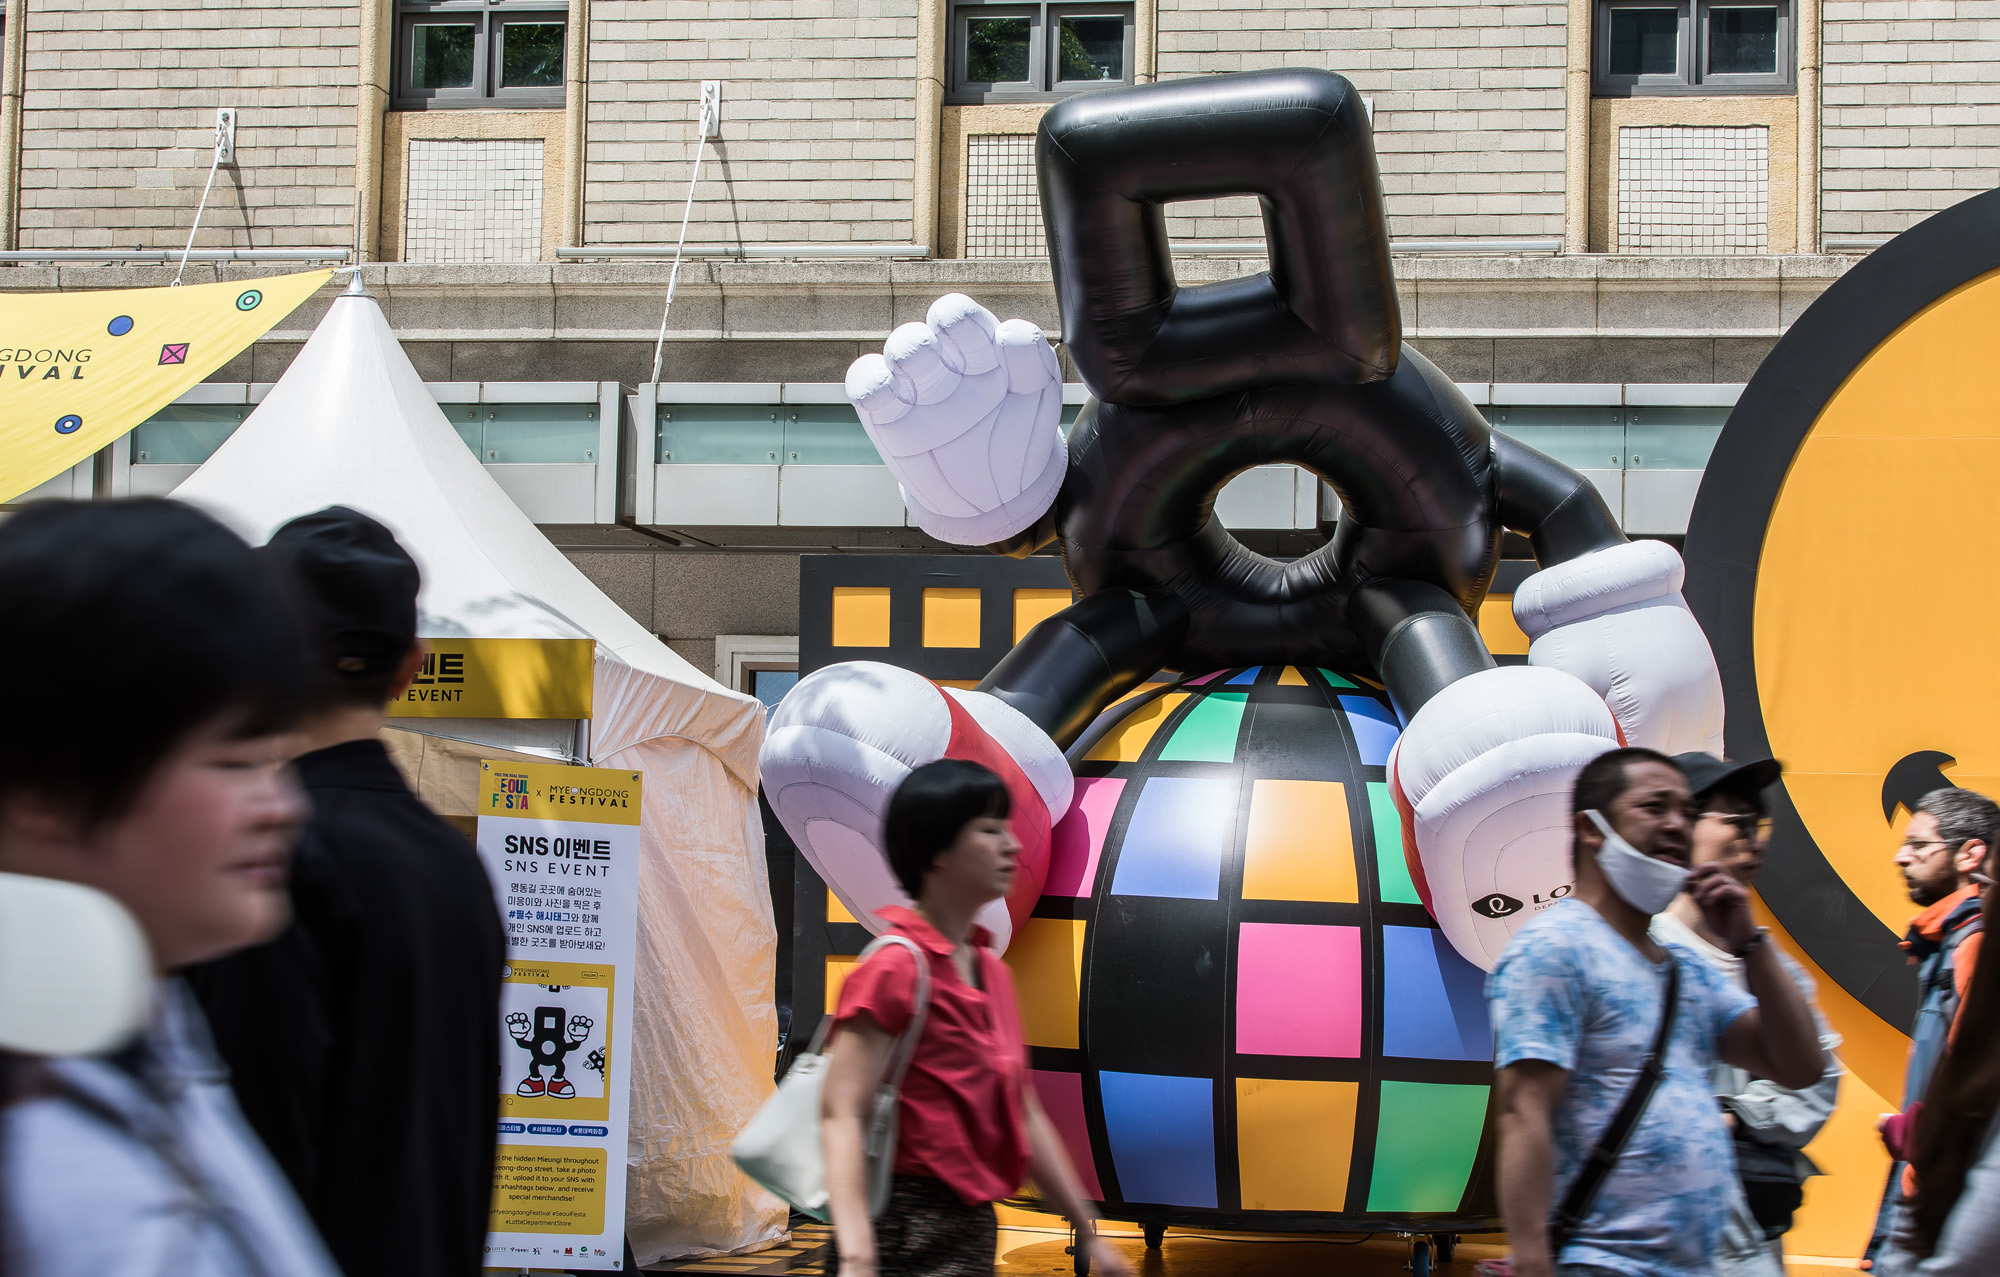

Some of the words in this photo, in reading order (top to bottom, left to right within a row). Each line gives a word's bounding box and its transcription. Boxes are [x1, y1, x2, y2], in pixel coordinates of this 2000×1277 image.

[408, 689, 464, 702] EVENT
[493, 777, 530, 794] SEOUL
[549, 785, 629, 799] MYEONGDONG
[492, 793, 529, 810] FESTA
[549, 795, 628, 808] FESTIVAL
[504, 834, 549, 856] SNS
[553, 837, 611, 860] 이벤트
[504, 860, 539, 873] SNS
[548, 862, 610, 877] EVENT
[510, 882, 537, 894] 명동길
[539, 884, 565, 896] 곳곳에
[567, 886, 602, 898] 숨어있는
[1532, 880, 1575, 904] LO
[544, 898, 571, 910] 사진을
[573, 900, 591, 910] 찍은
[592, 901, 602, 911] 후
[508, 909, 533, 920] #필수
[535, 911, 579, 923] 해시태그와
[581, 913, 599, 924] 함께
[507, 922, 525, 933] 개인
[527, 924, 554, 935] SNS에
[556, 925, 582, 936] 업로드
[584, 926, 602, 937] 하고
[531, 937, 557, 948] 굿즈를
[559, 938, 606, 950] 받아보세요!
[563, 1157, 599, 1165] throughout
[501, 1184, 534, 1192] #hashtags
[532, 1194, 575, 1202] merchandise!
